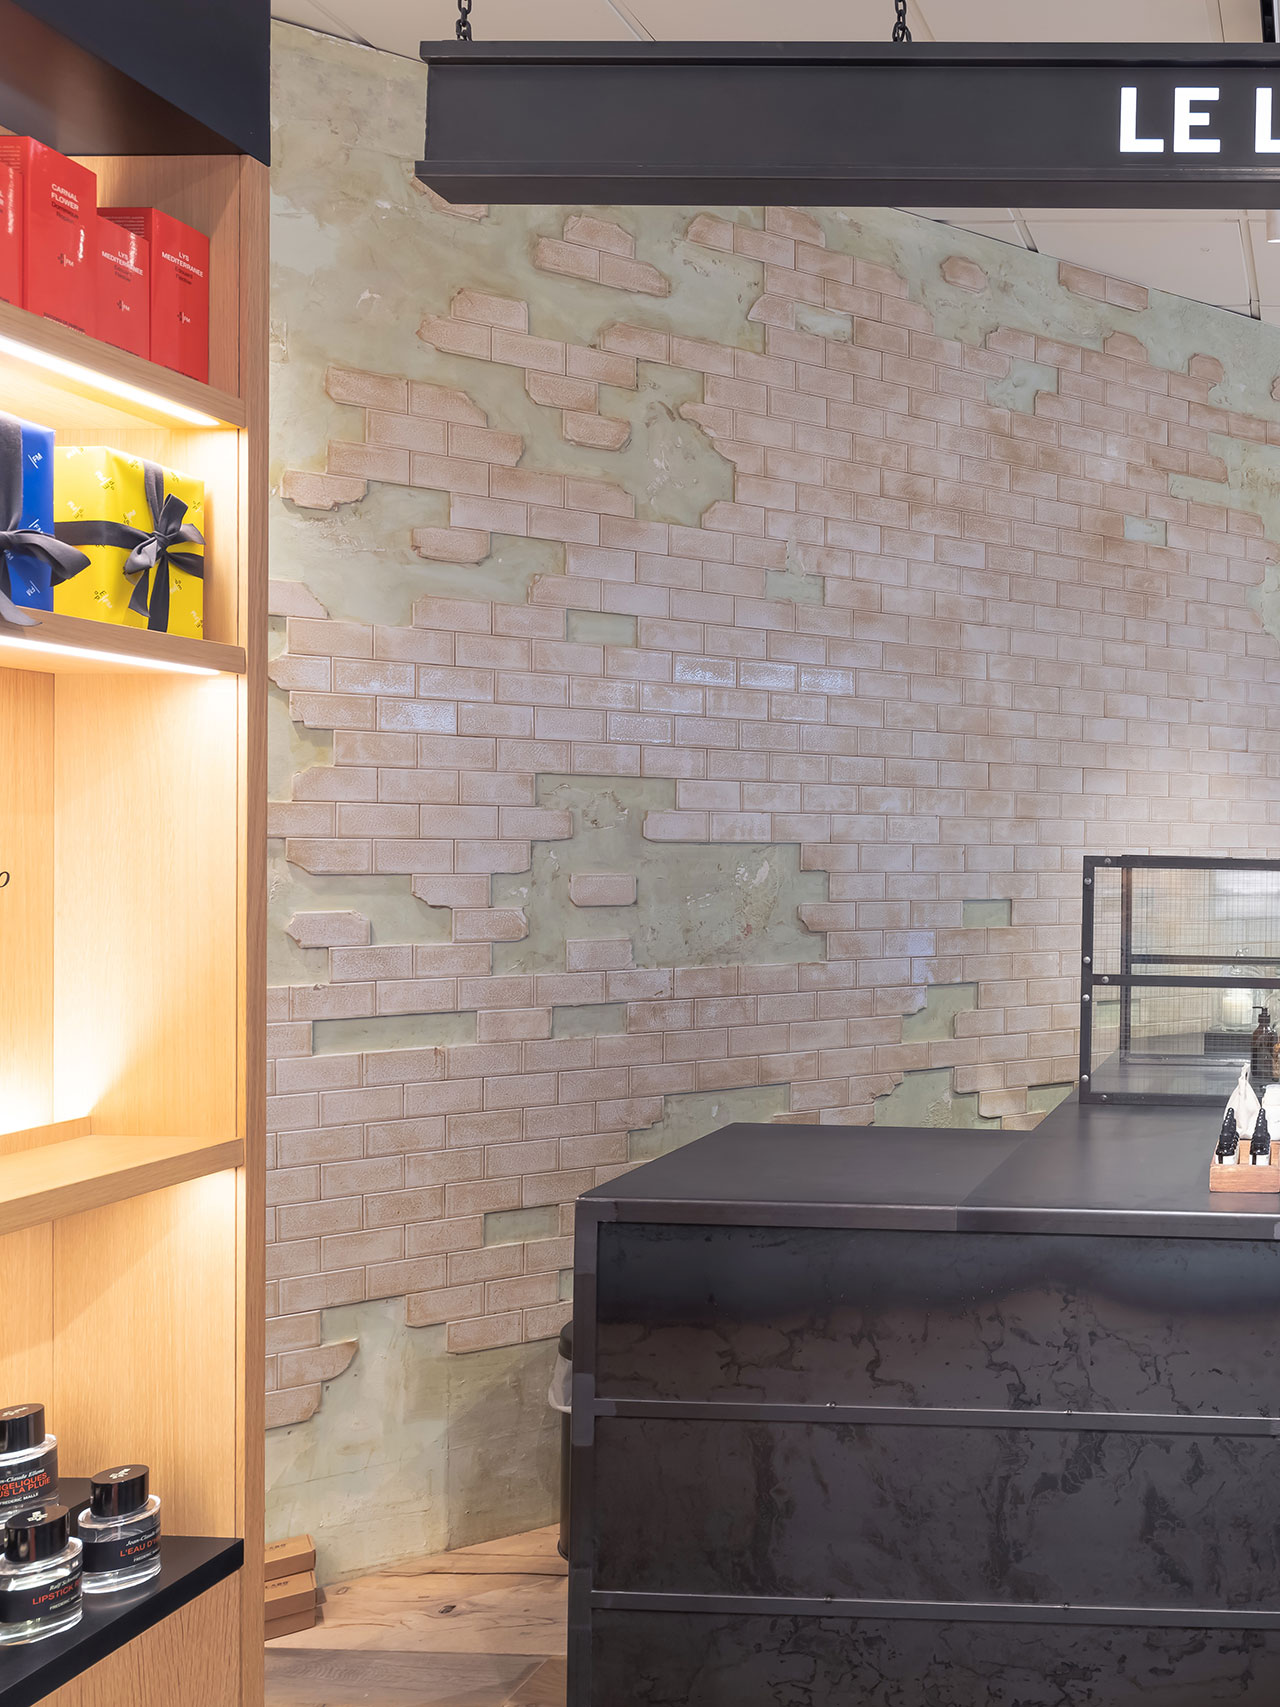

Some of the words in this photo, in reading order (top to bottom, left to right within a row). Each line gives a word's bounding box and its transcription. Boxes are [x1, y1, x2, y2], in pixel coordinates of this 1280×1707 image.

[1118, 86, 1221, 154] LE
[51, 183, 79, 203] CARNAL
[51, 192, 79, 211] FLOWER
[118, 251, 129, 261] LYS
[178, 252, 190, 262] LYS
[32, 452, 43, 464] FM
[0, 1472, 48, 1491] GELIQUES
[12, 1486, 26, 1495] LA
[28, 1476, 51, 1491] PLUIE
[120, 1543, 146, 1558] L'EAU
[32, 1583, 74, 1606] LIPSTICK
